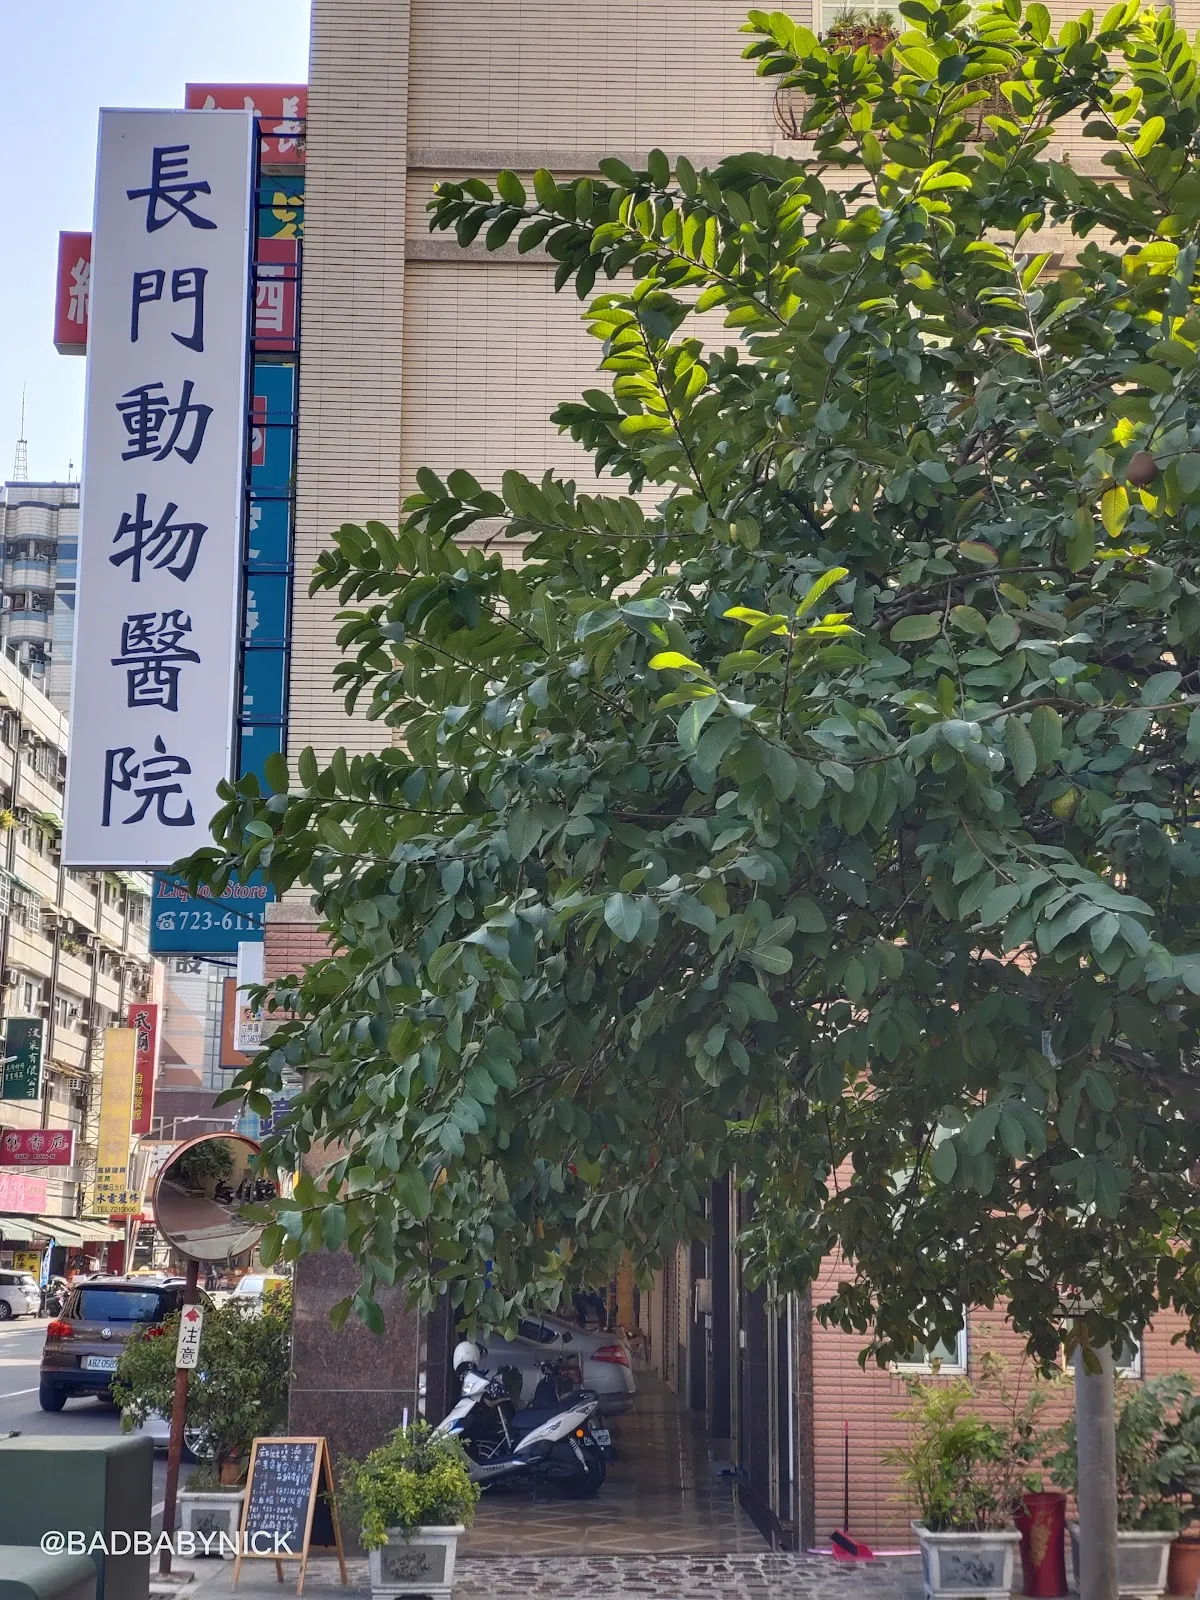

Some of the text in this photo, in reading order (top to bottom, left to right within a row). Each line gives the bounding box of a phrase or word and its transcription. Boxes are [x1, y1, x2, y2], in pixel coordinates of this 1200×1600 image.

[101, 144, 218, 827] 長門動物醫院
[220, 880, 268, 899] Store
[96, 1192, 140, 1205] 水電裝修
[179, 1326, 200, 1365] 注意
